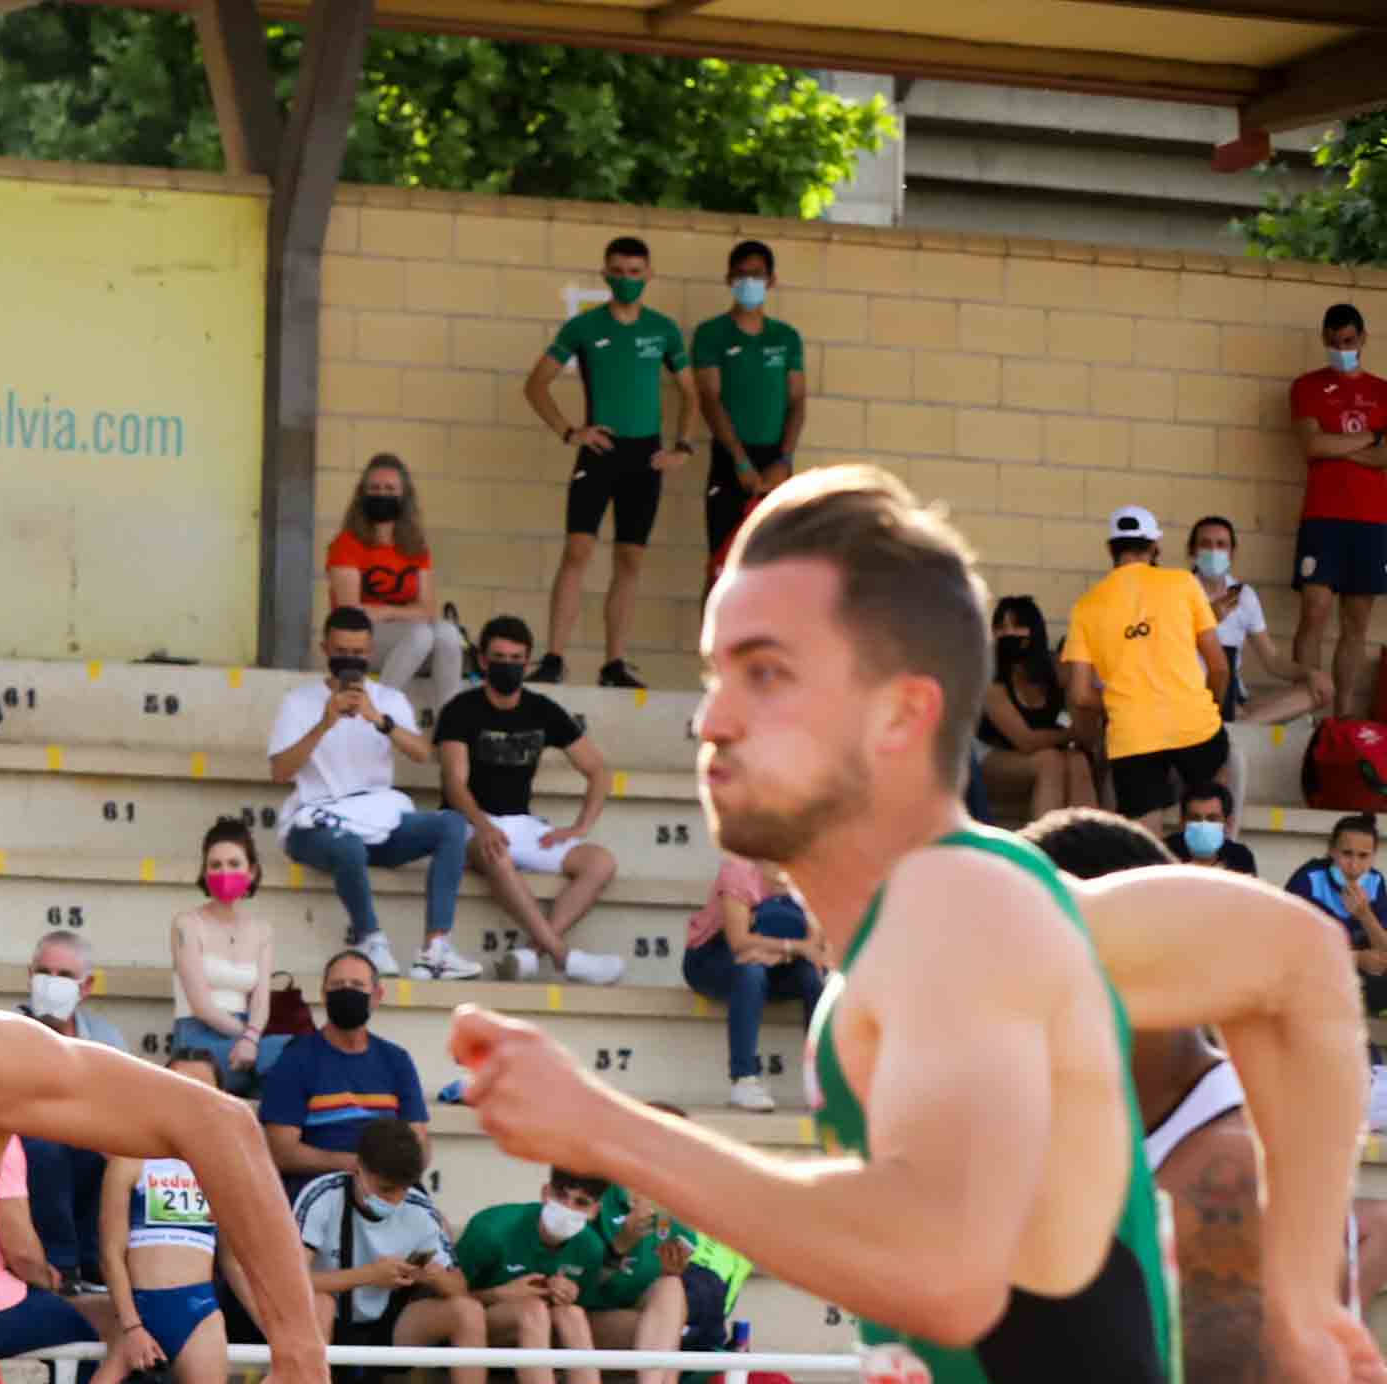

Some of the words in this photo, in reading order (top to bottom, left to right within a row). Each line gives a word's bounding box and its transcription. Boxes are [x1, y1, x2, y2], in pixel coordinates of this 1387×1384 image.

[3, 687, 36, 709] 61
[143, 694, 180, 716] 59
[102, 801, 135, 823] 61
[482, 929, 519, 951] 57
[595, 1048, 633, 1071] 57
[429, 1171, 441, 1193] 1
